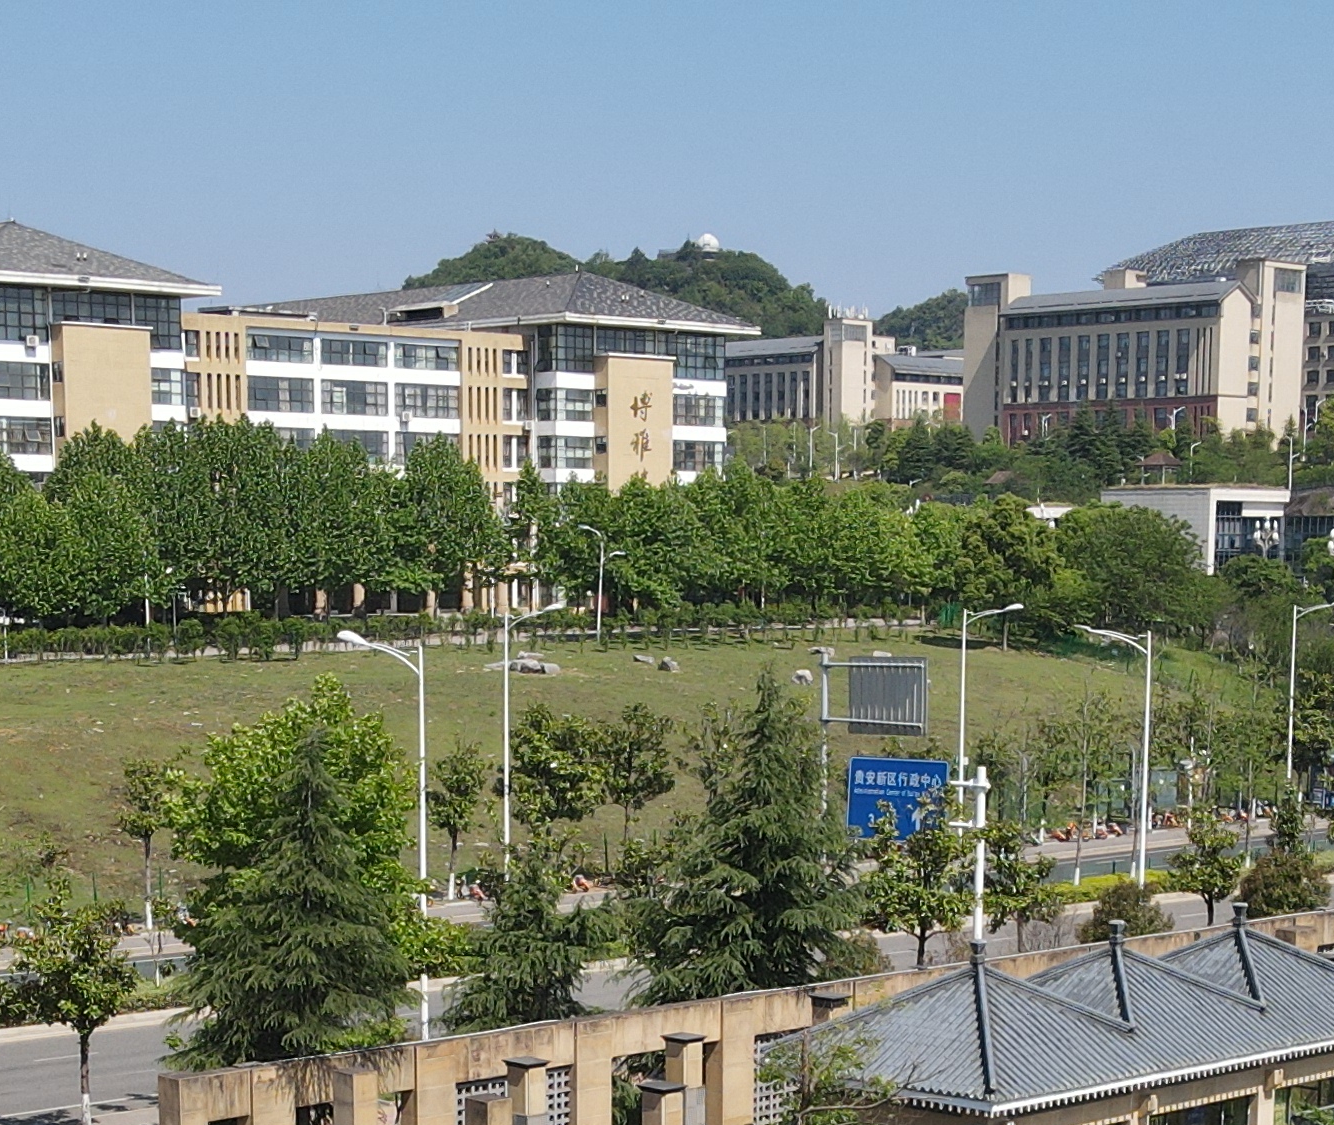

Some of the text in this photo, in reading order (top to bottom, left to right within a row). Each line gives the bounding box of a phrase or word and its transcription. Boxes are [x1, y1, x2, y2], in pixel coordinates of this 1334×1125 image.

[630, 390, 652, 478] 博雅
[854, 769, 942, 788] 贵安新区行政中心
